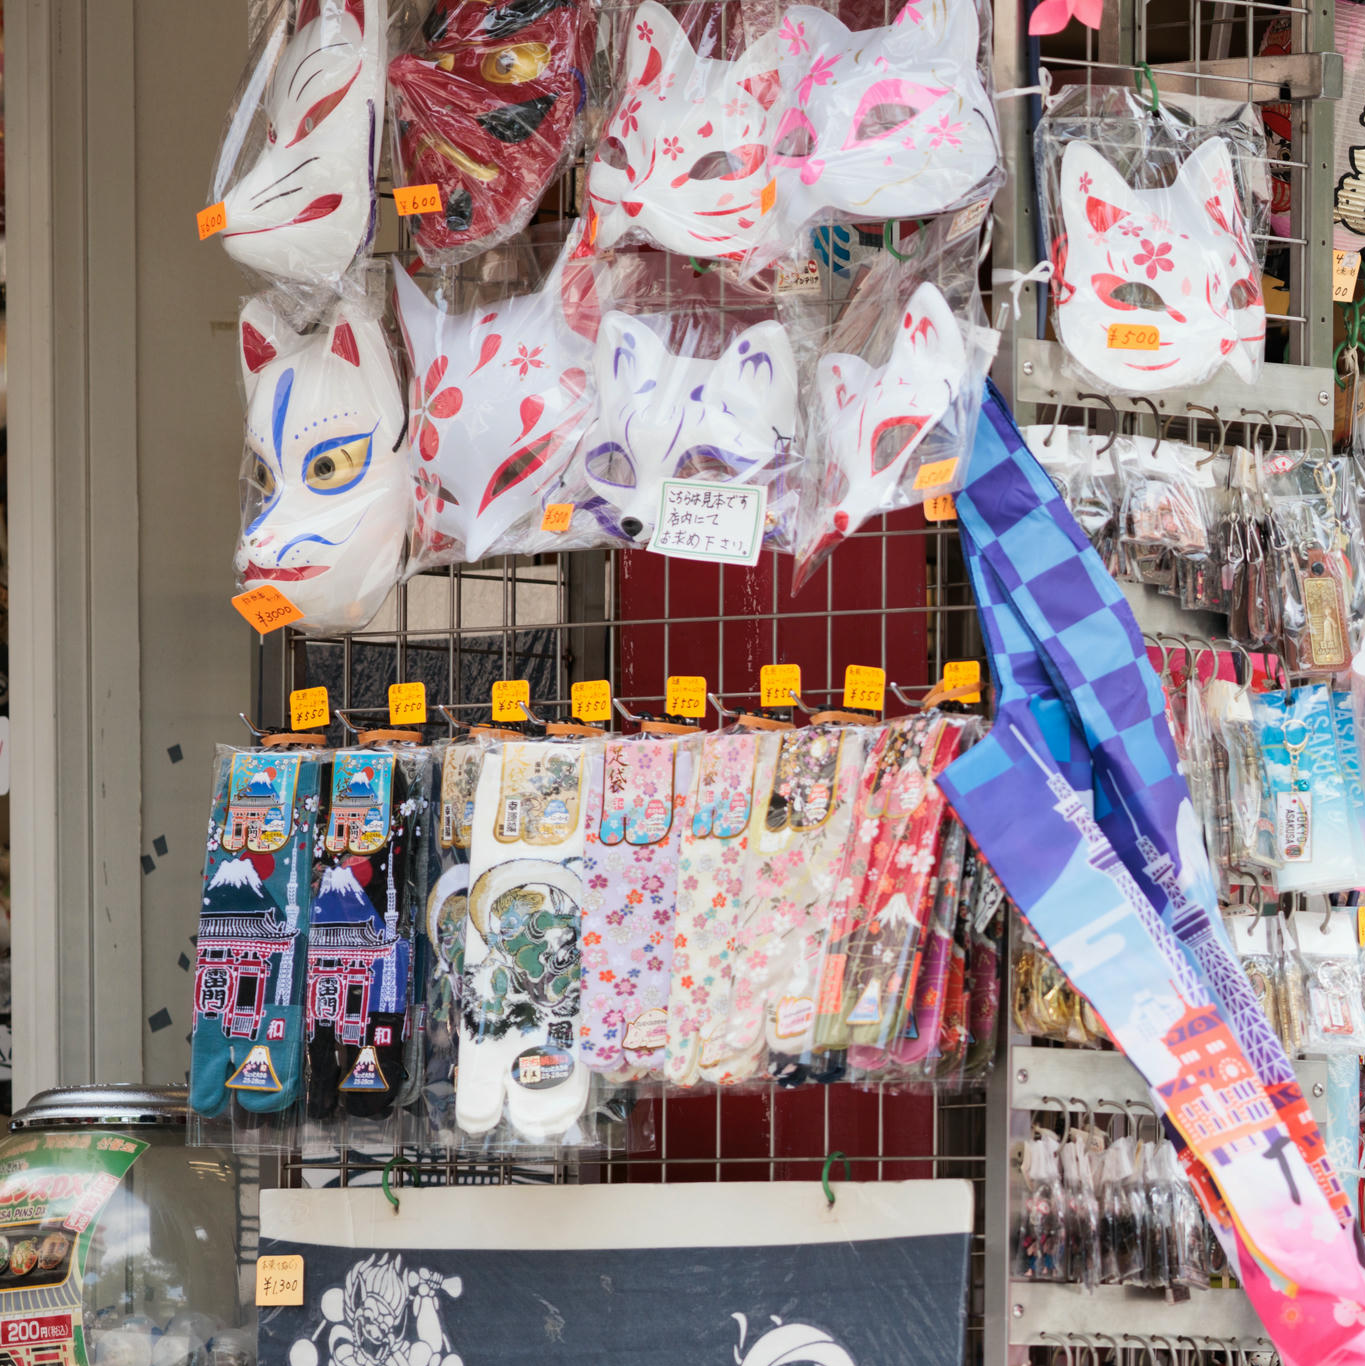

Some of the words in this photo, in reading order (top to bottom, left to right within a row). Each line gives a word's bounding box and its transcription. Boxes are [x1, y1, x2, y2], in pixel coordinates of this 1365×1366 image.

[399, 195, 437, 214] ¥600
[1108, 326, 1159, 347] ¥500
[668, 489, 750, 510] こちらは見本です
[666, 508, 720, 527] 店内にて
[671, 697, 701, 713] ¥550
[849, 687, 882, 704] ¥550
[295, 708, 326, 723] ¥550
[393, 700, 423, 715] ¥550
[575, 699, 608, 717] ¥550
[1308, 702, 1343, 805] ASAKUSA
[607, 745, 630, 794] 足袋
[1285, 807, 1294, 846] ASAKUSA
[200, 967, 229, 1012] 雷門
[314, 974, 338, 1018] 雷門
[266, 1018, 285, 1041] 和
[374, 1026, 392, 1046] 和
[13, 1207, 33, 1219] PINS
